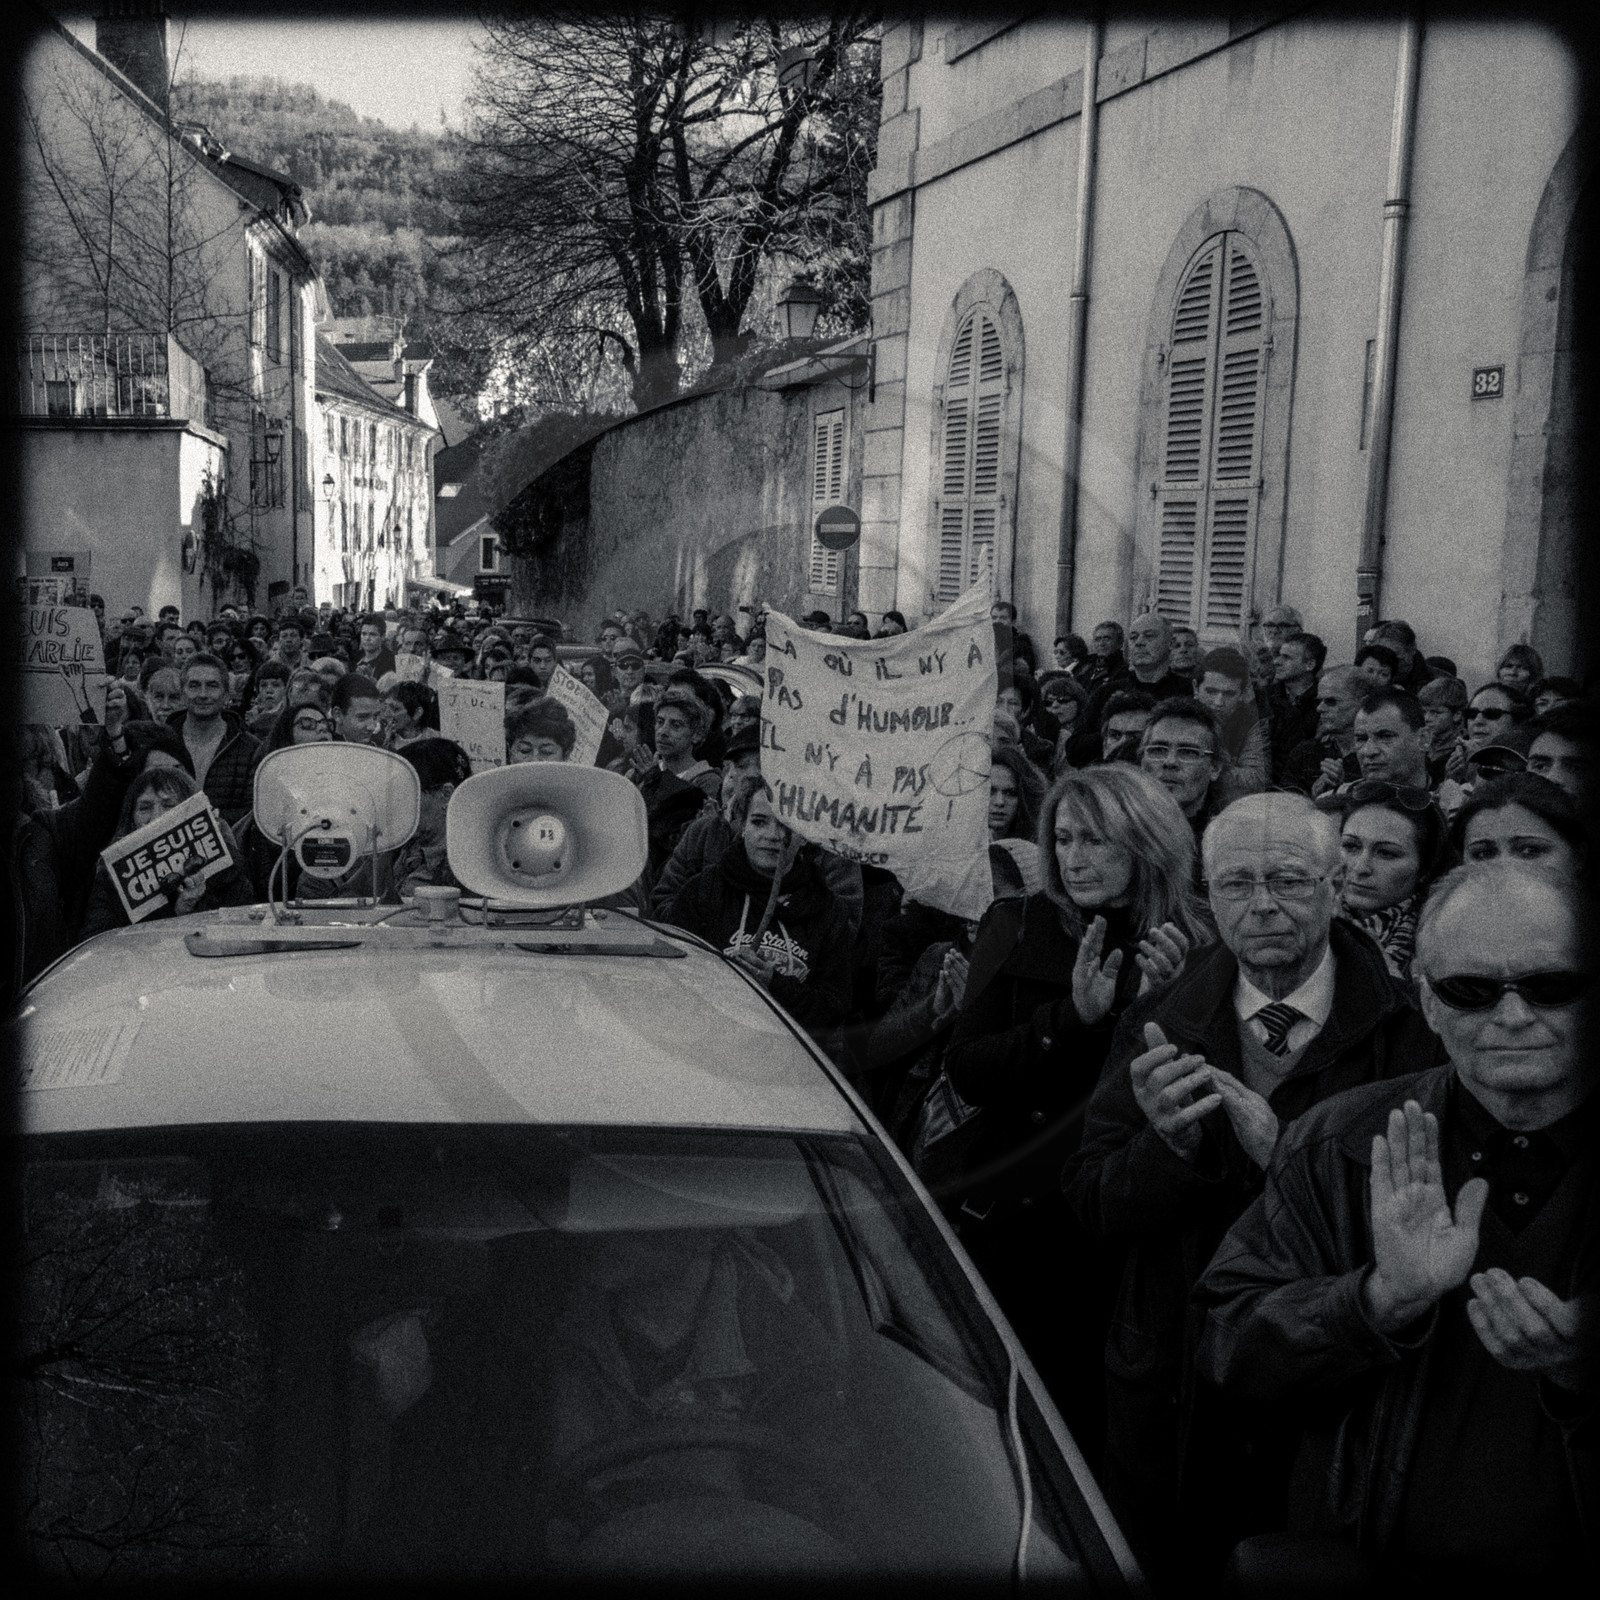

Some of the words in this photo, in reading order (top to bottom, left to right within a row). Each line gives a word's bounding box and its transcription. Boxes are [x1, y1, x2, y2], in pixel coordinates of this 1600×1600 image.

[1475, 371, 1500, 393] 32
[767, 666, 804, 711] PAS
[760, 716, 787, 753] IL
[854, 753, 873, 789] À
[892, 762, 932, 798] PAS
[946, 799, 954, 830] !
[121, 848, 154, 879] JE
[152, 815, 210, 860] SUIS
